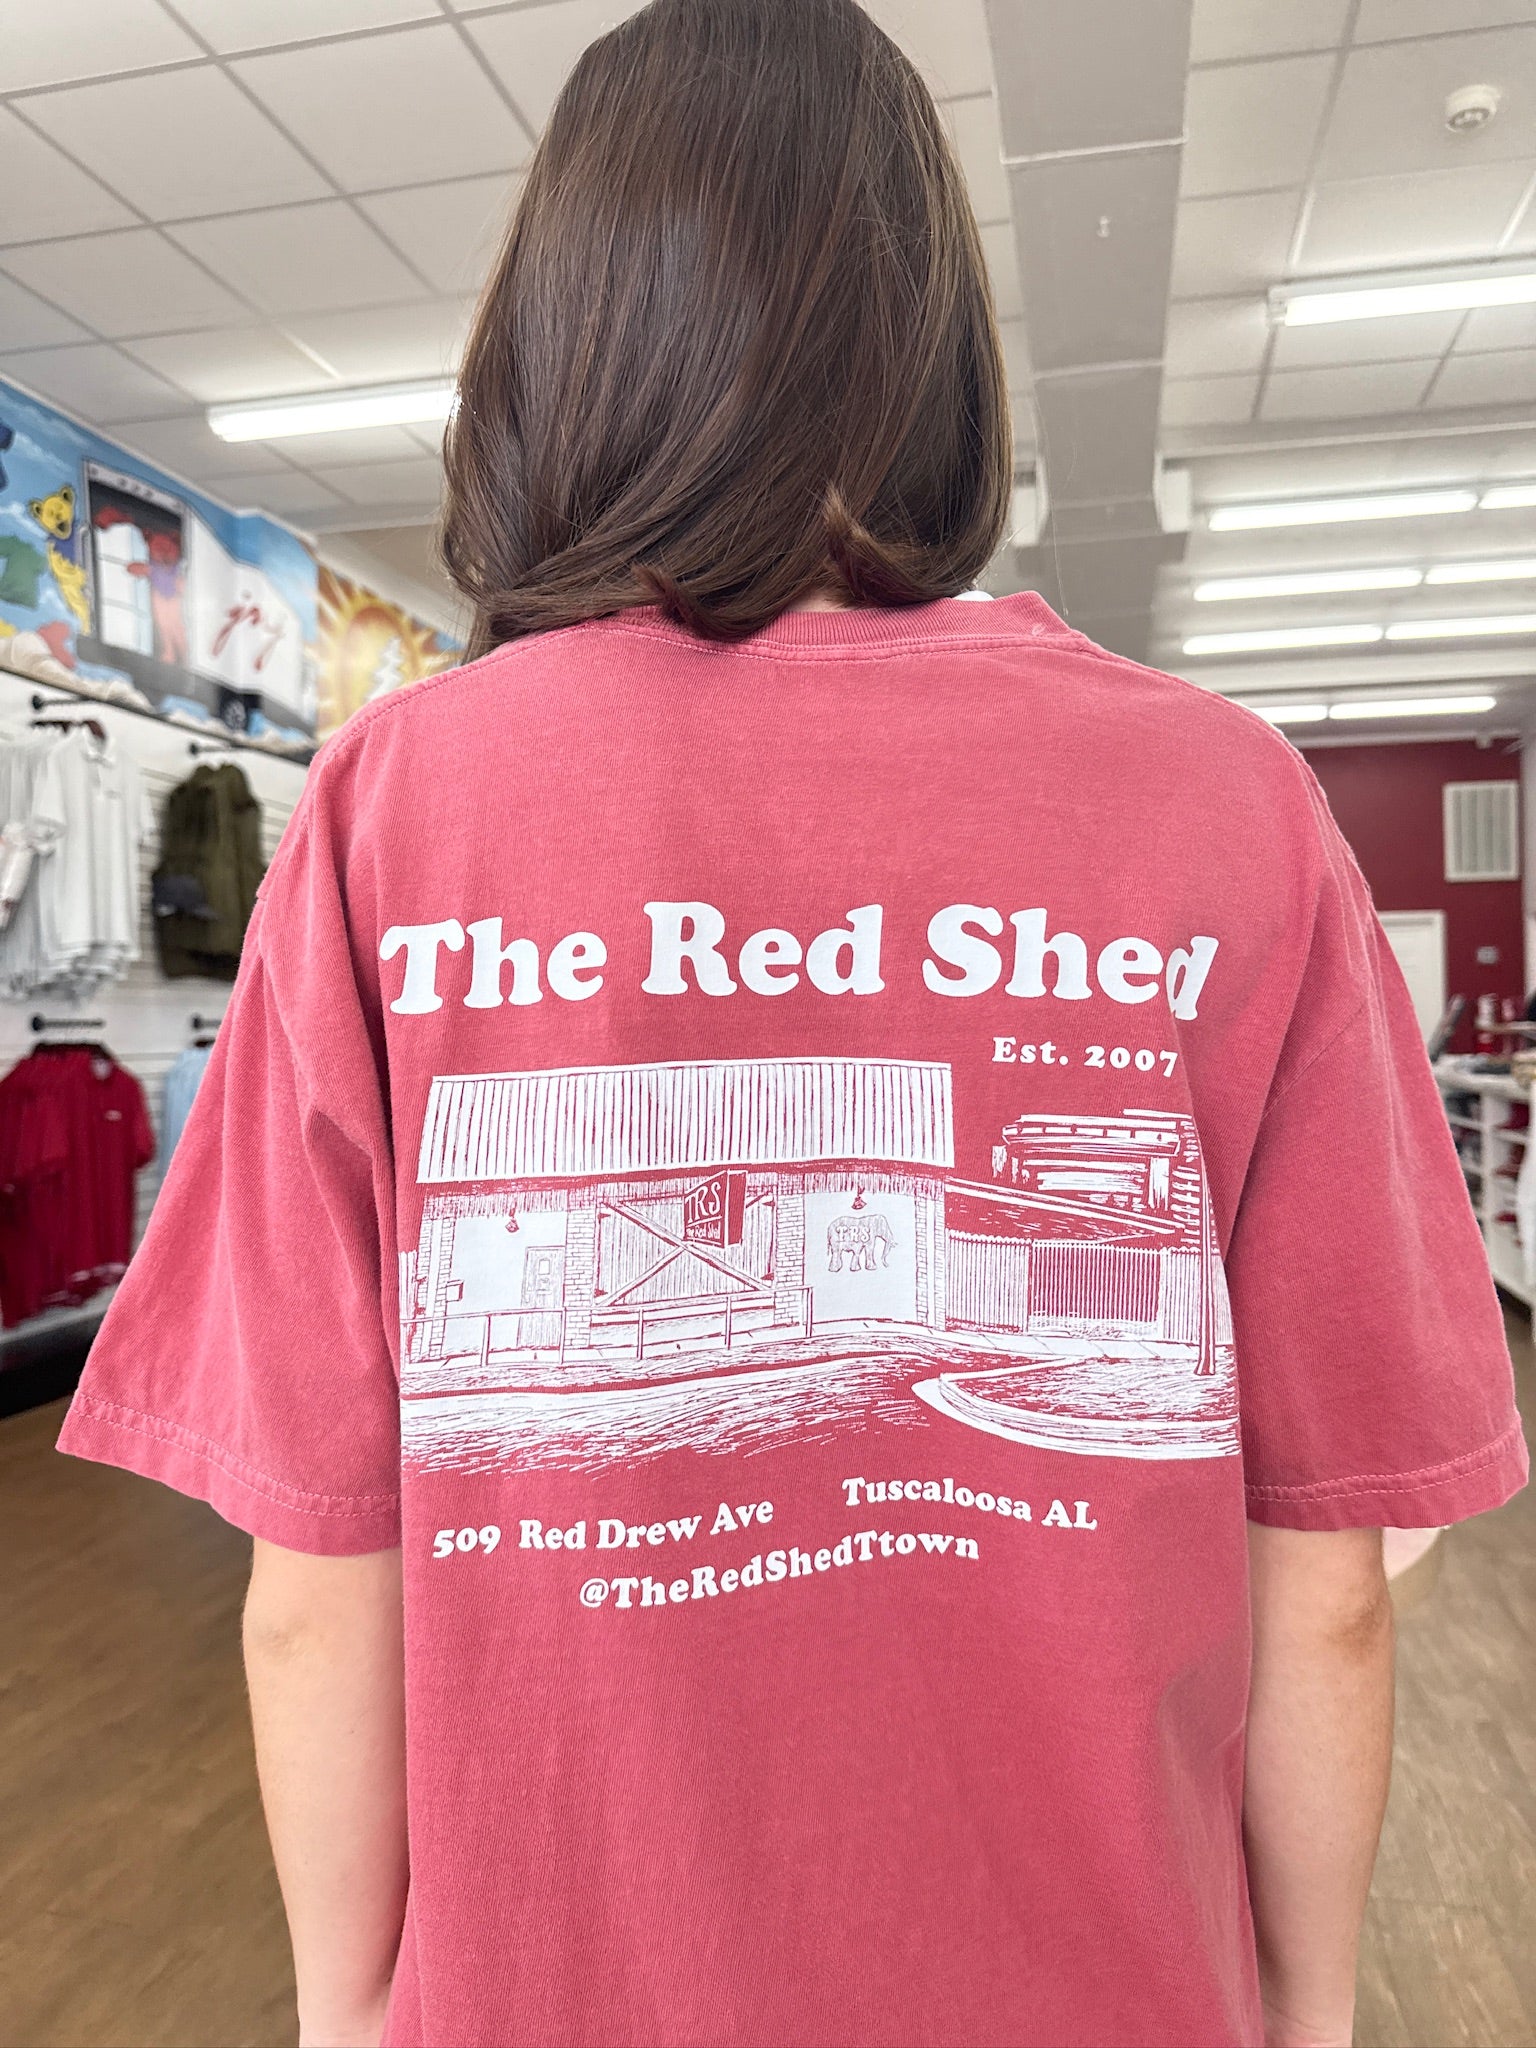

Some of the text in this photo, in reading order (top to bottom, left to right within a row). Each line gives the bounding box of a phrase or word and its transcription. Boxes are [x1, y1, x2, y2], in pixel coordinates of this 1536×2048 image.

[378, 901, 1220, 1021] The Red Shed
[991, 1036, 1179, 1078] Est. 2007
[684, 1181, 722, 1224] TRS
[836, 1224, 871, 1243] TRS
[432, 1500, 774, 1559] 509 Red Drew Ave
[841, 1475, 1098, 1531] Tuscaloosa AL
[579, 1529, 980, 1609] @TheRedShedTtown
